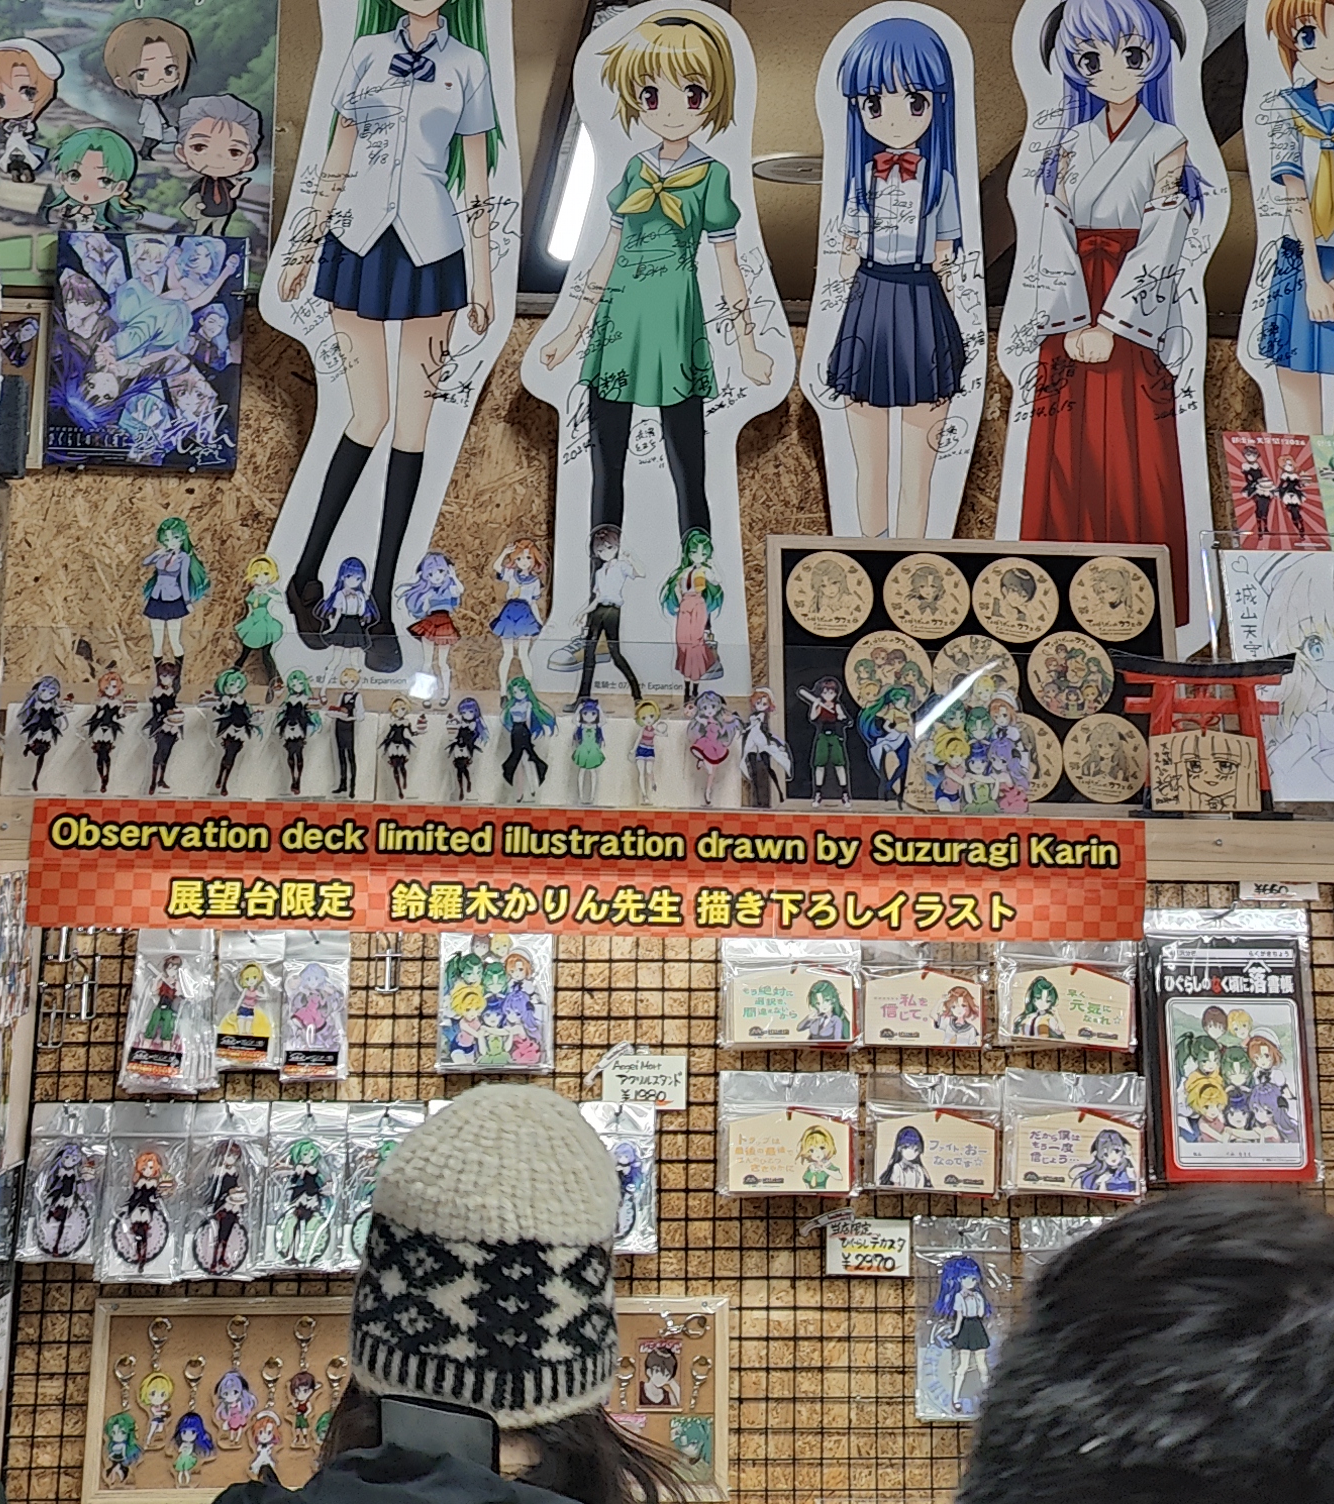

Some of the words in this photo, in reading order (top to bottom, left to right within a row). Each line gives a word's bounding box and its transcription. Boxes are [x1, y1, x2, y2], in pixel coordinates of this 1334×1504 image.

[1235, 584, 1264, 660] 城山天守
[52, 817, 268, 850] Observation
[281, 820, 365, 851] deck
[379, 822, 492, 854] limited
[504, 824, 685, 858] illustration
[696, 830, 805, 860] drawn
[816, 833, 859, 866] by
[872, 834, 1019, 870] Suzuragi
[1031, 837, 1118, 866] Karin
[168, 879, 354, 918] 展望台限定
[390, 883, 681, 923] 鈴羅木かりん先生
[697, 889, 1017, 930] 描き下ろしイラスト
[741, 984, 794, 997] もう絶対に
[1163, 967, 1295, 995] ひぐらしのなく頃に落書帳
[1066, 988, 1086, 999] 早く
[880, 1002, 929, 1022] 信じて。
[1069, 999, 1112, 1015] 元気に
[1029, 1130, 1081, 1142] だから僕は
[1031, 1142, 1074, 1154] もう一度
[841, 1252, 897, 1272] ¥2970
